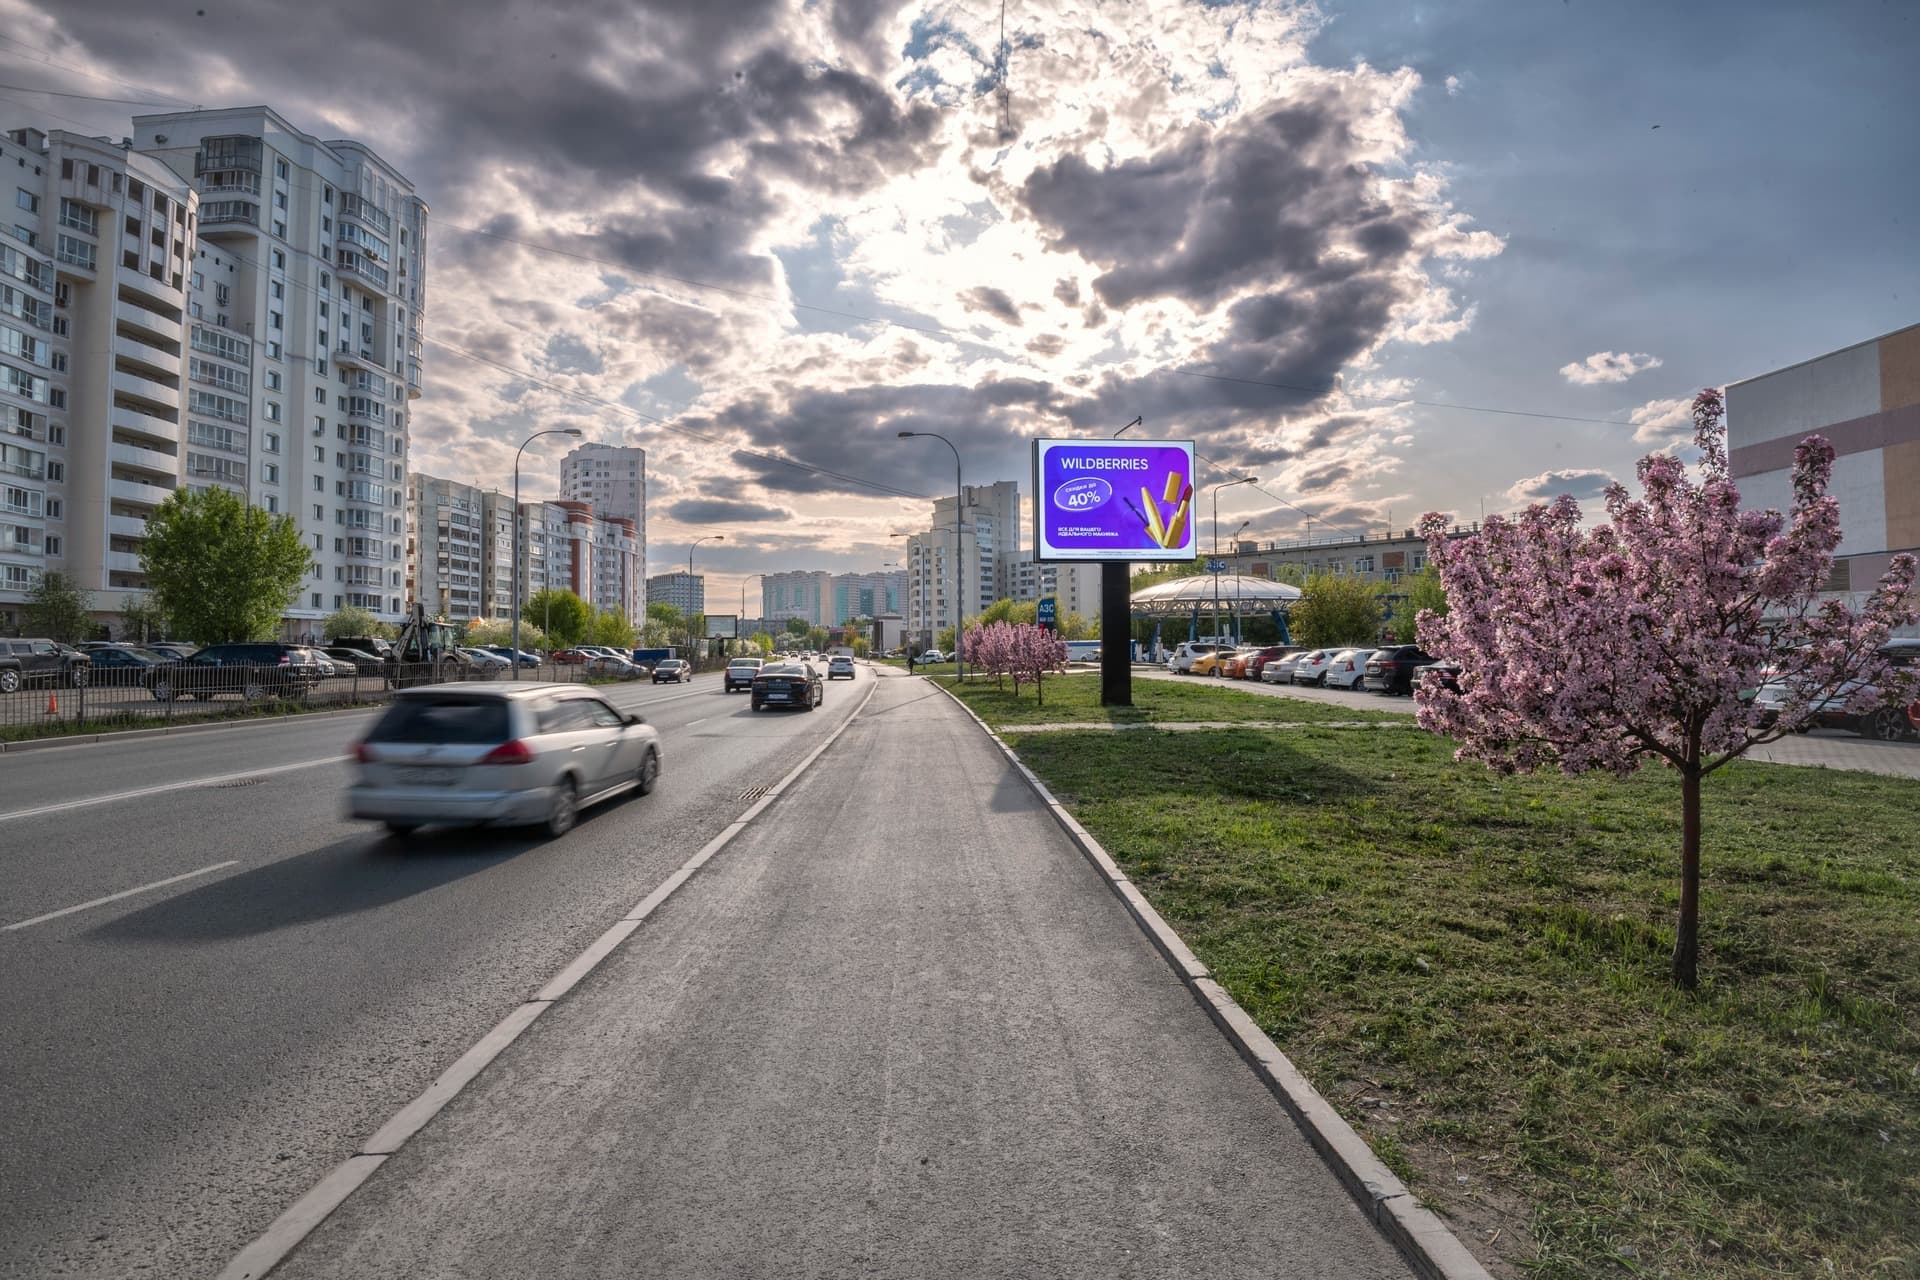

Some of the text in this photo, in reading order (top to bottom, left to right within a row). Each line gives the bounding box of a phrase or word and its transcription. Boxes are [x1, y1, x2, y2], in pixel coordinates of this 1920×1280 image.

[1061, 458, 1148, 470] WILDBERRIES
[1068, 490, 1101, 506] 40%
[1040, 604, 1054, 612] АЗС
